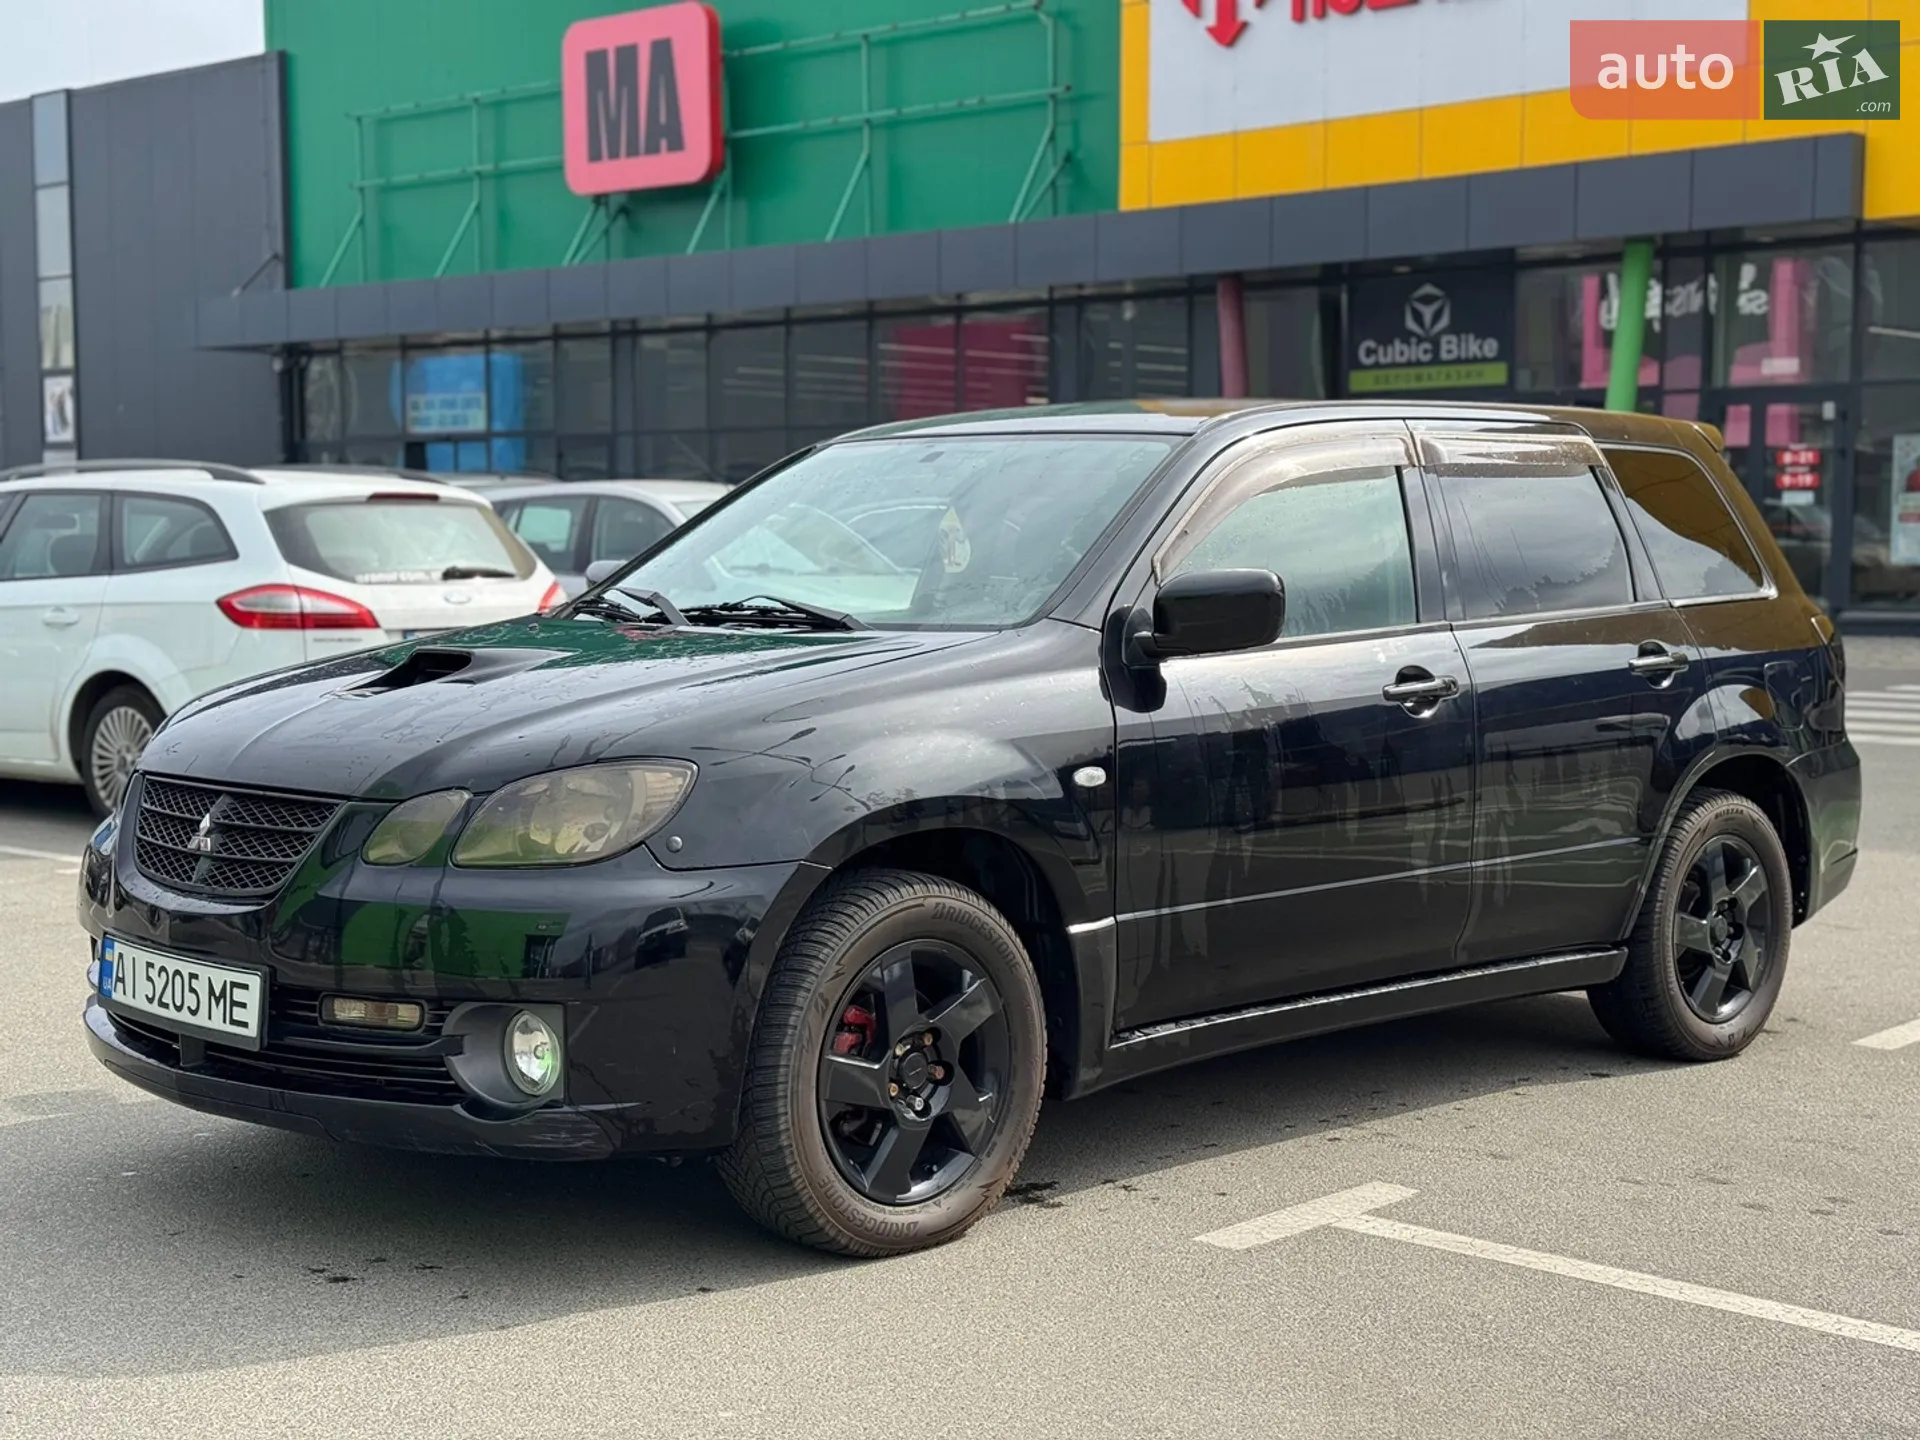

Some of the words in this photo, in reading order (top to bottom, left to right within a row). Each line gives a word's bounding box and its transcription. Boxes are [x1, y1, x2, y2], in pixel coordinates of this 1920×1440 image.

[585, 36, 685, 163] MA
[1358, 337, 1433, 366] Cubic
[1439, 333, 1499, 361] Bike
[930, 901, 1020, 975] BRIDGESTONE
[102, 978, 113, 991] UA
[113, 952, 136, 1000] AI
[145, 961, 201, 1017] 5205
[207, 976, 250, 1030] ME
[817, 1176, 920, 1238] BRIDGESTONE
